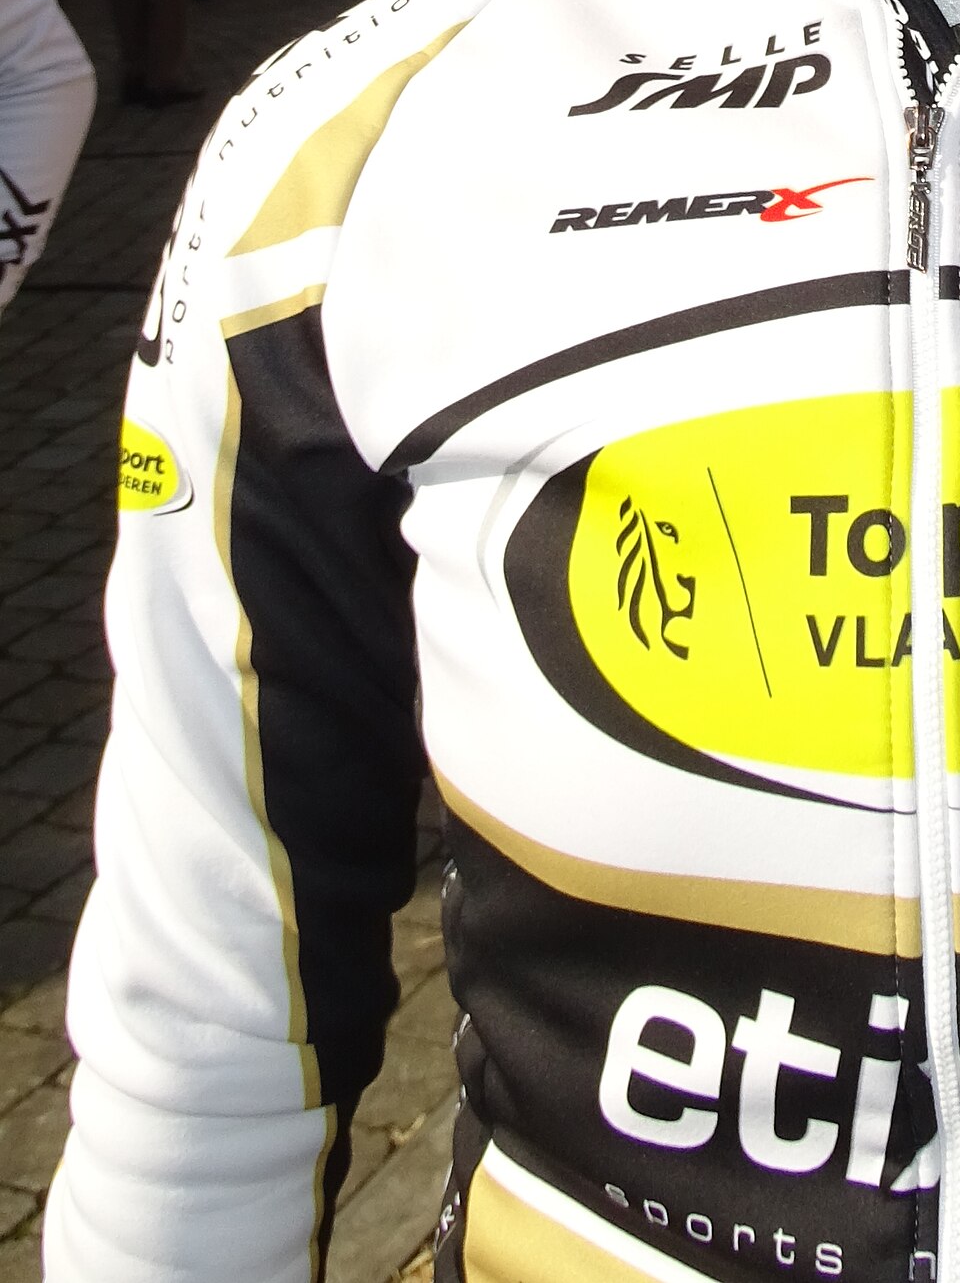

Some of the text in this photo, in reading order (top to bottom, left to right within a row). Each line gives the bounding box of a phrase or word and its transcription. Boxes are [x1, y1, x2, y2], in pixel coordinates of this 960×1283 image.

[618, 20, 823, 70] SELLE
[567, 52, 832, 117] SMP
[549, 177, 876, 234] REMERX
[603, 1181, 844, 1274] sports
